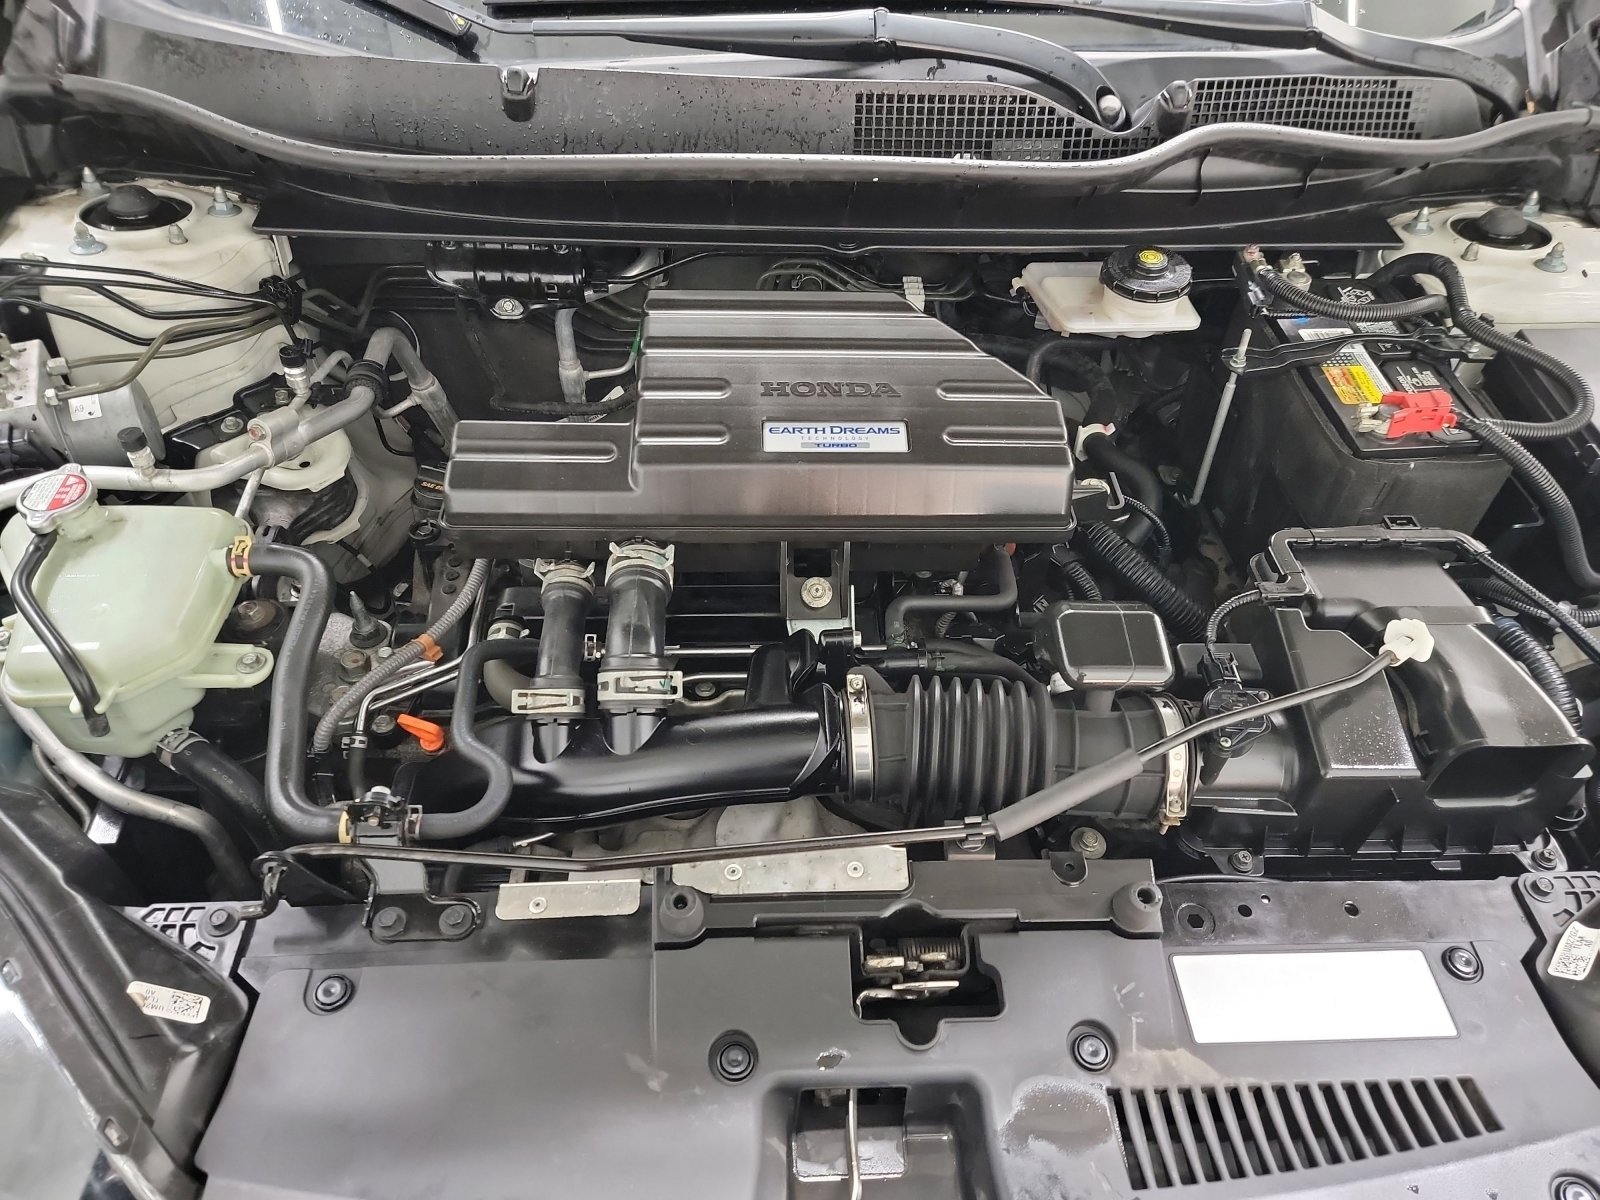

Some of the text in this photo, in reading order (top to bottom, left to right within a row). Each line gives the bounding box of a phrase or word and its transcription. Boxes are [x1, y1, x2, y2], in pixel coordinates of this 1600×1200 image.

[760, 381, 902, 398] HONDA
[768, 425, 901, 435] EARTH DREAMS
[420, 481, 436, 489] SAE
